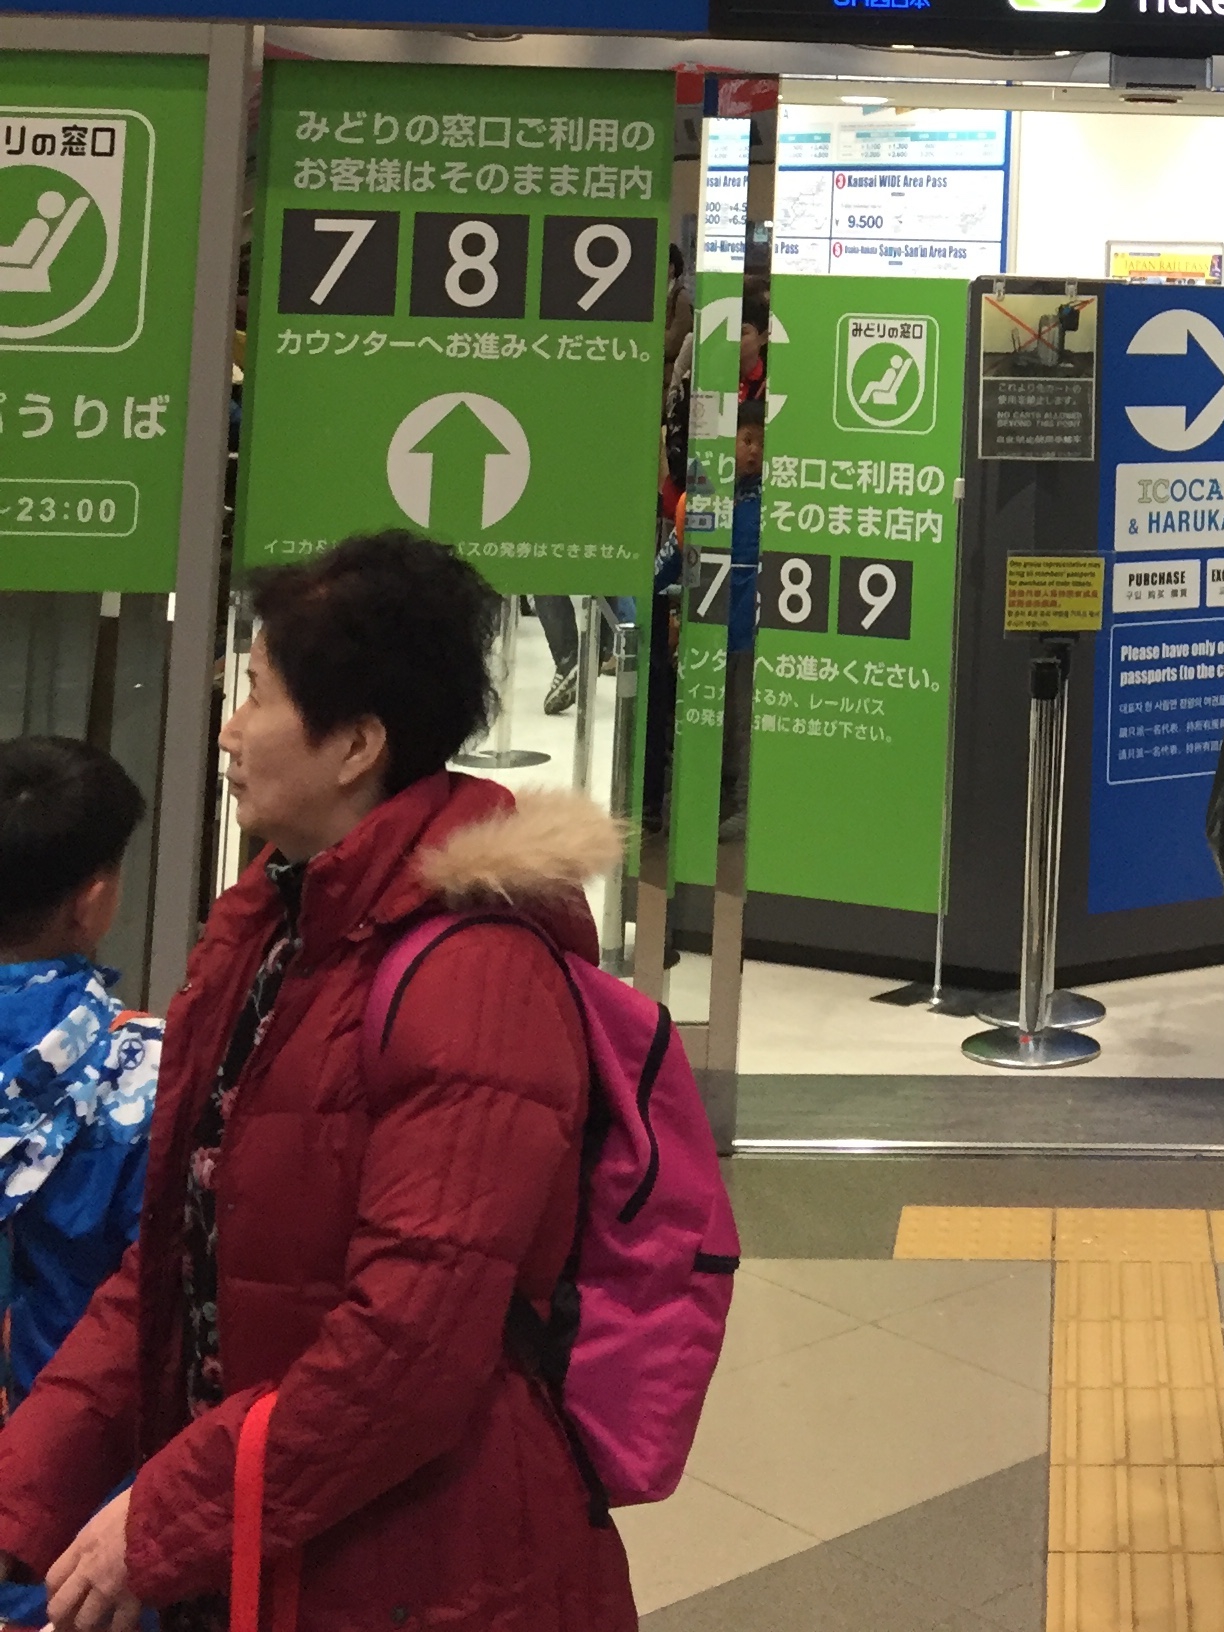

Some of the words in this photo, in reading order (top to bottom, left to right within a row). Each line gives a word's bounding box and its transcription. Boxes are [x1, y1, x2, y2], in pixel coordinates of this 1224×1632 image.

[294, 110, 656, 153] みどりの窓口ご利用の
[293, 157, 653, 201] お客様はそのまま店内
[310, 218, 377, 306] 7
[444, 220, 500, 308] 8
[573, 223, 633, 313] 9
[276, 328, 652, 364] カウンターへお進みください。
[851, 322, 924, 340] みどりの窓口
[0, 392, 170, 440] うりば
[1137, 477, 1224, 504] ICOCA
[778, 558, 812, 624] 8
[858, 563, 897, 630] 9
[1128, 571, 1186, 587] PURCHASE
[1120, 645, 1160, 662] Please
[1162, 643, 1190, 658] have
[1191, 640, 1216, 657] only
[1120, 667, 1178, 687] passports
[1197, 663, 1215, 679] the
